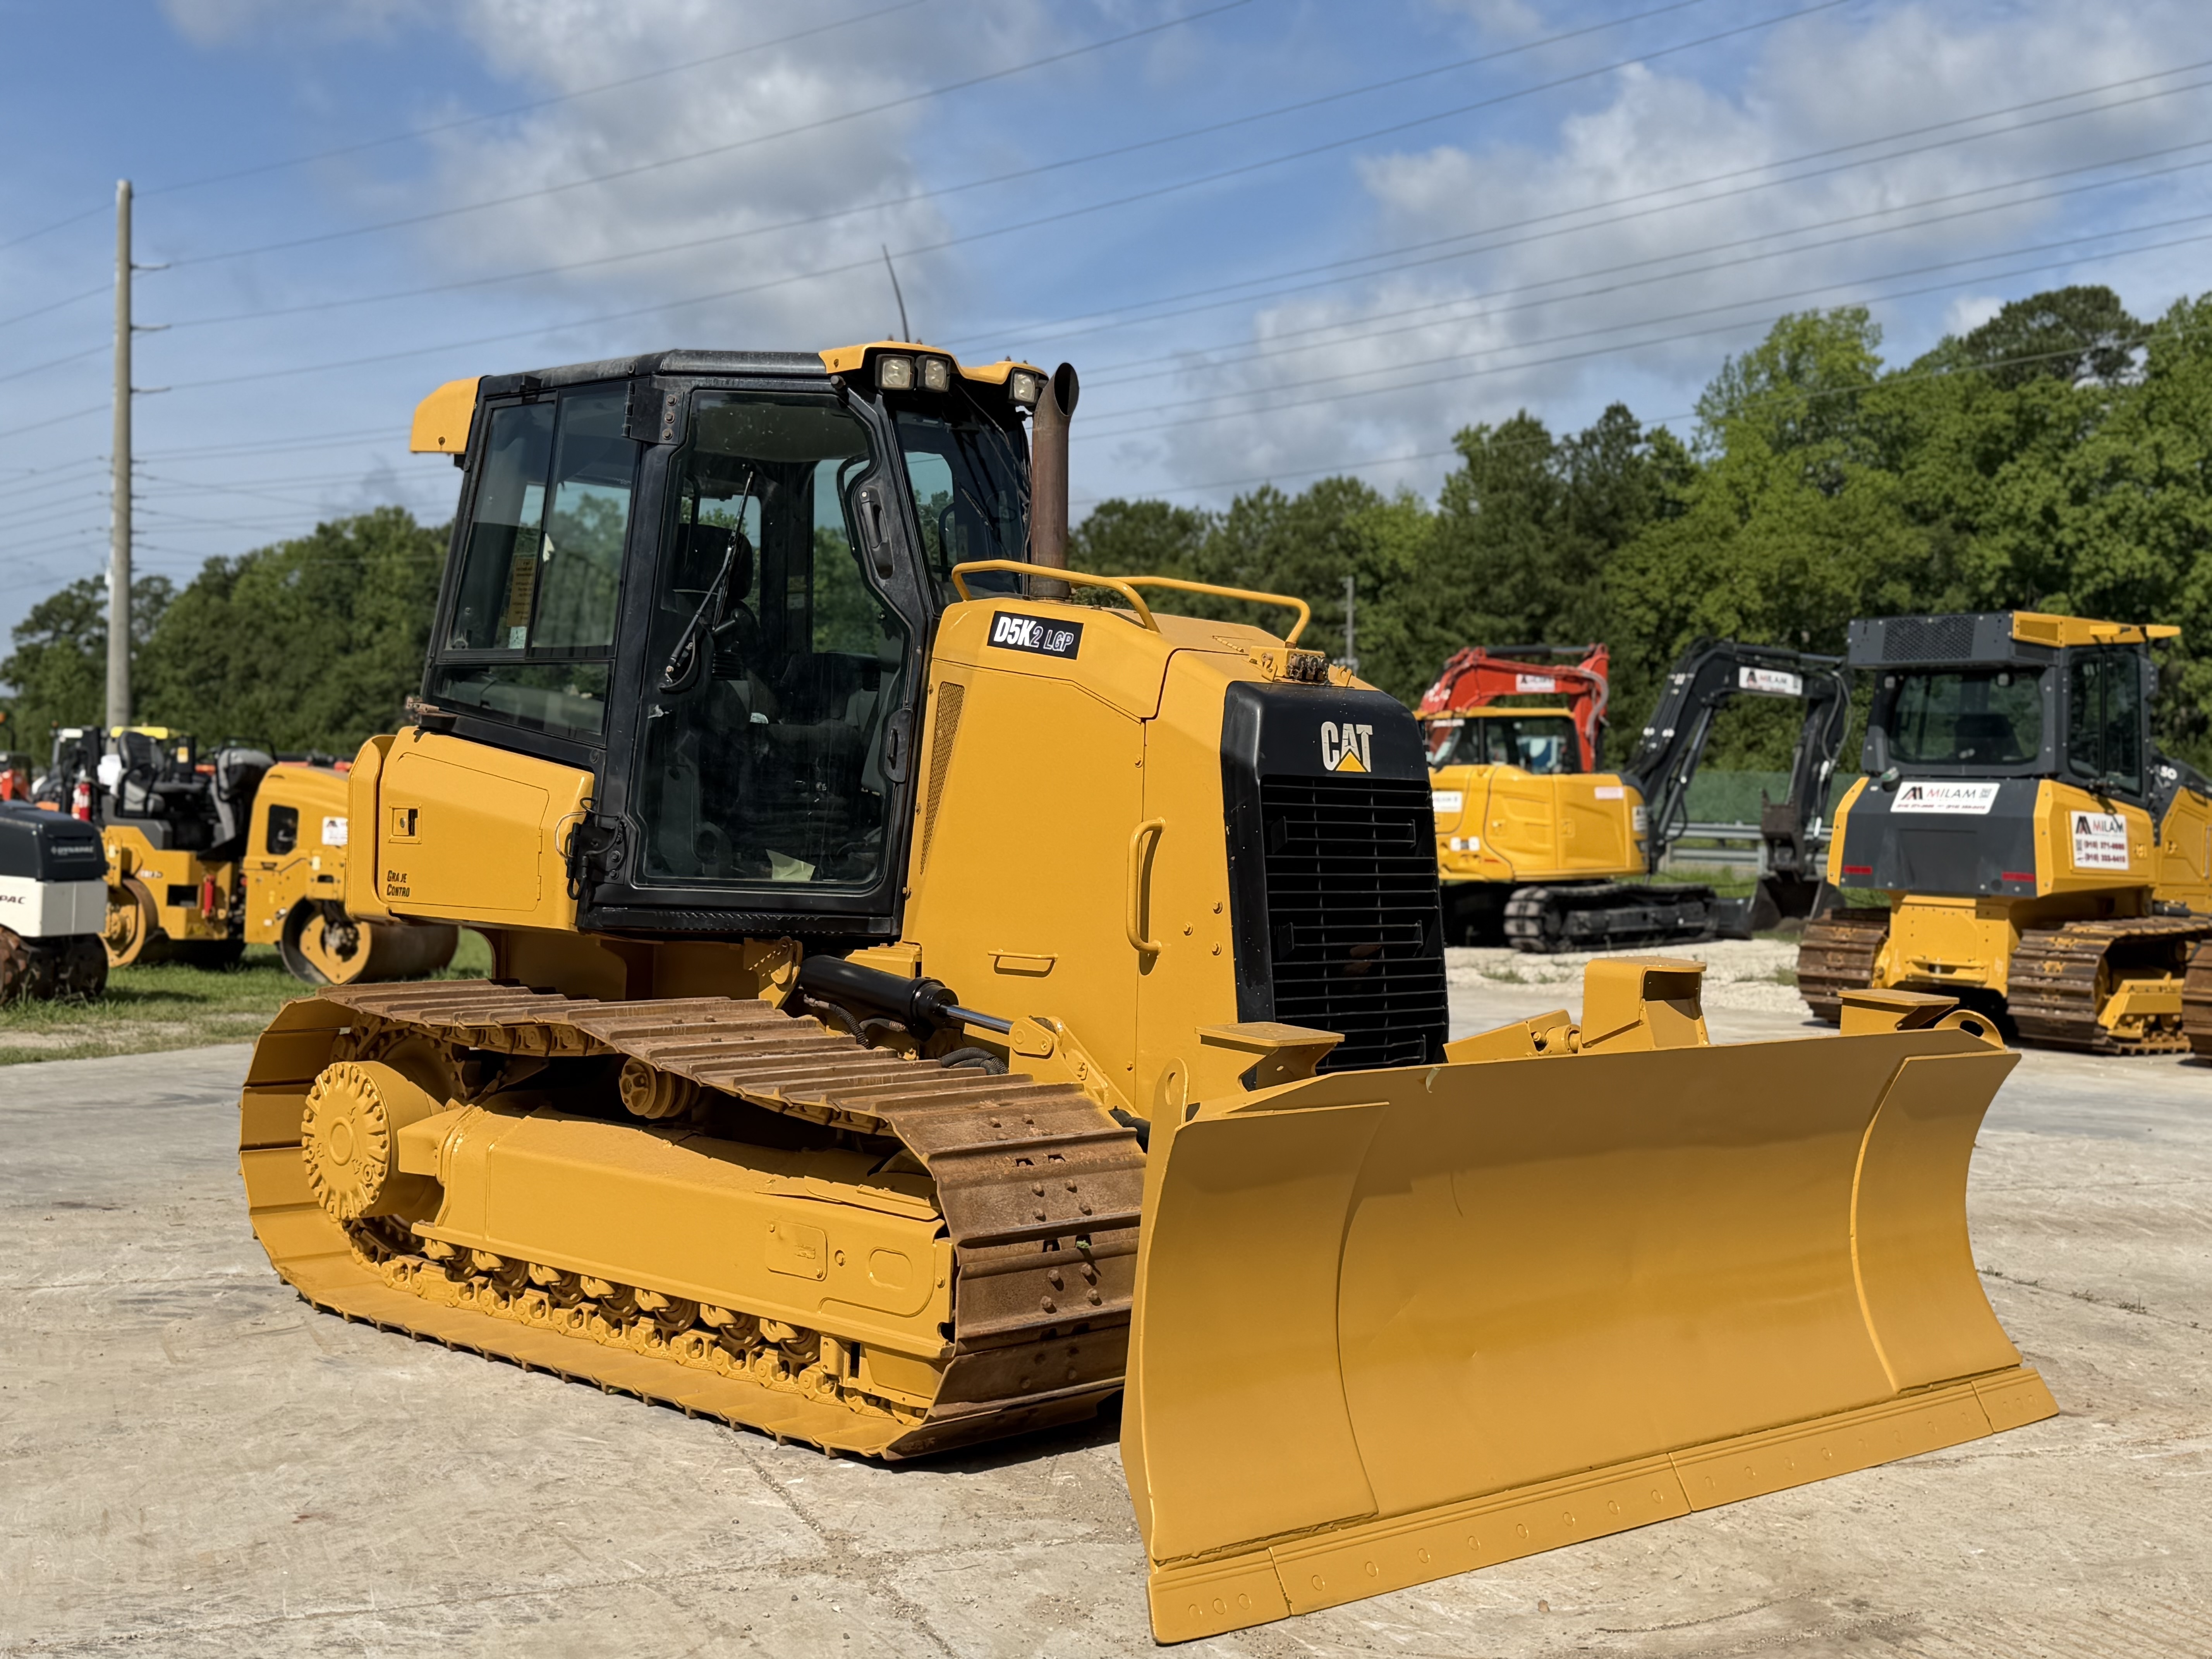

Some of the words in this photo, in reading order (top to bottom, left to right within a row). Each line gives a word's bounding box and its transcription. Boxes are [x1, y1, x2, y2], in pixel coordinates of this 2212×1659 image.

[1043, 630, 1074, 652] LGP
[1321, 721, 1373, 772] CAT
[1926, 788, 1976, 799] MILAM
[2093, 819, 2124, 833] MILAM
